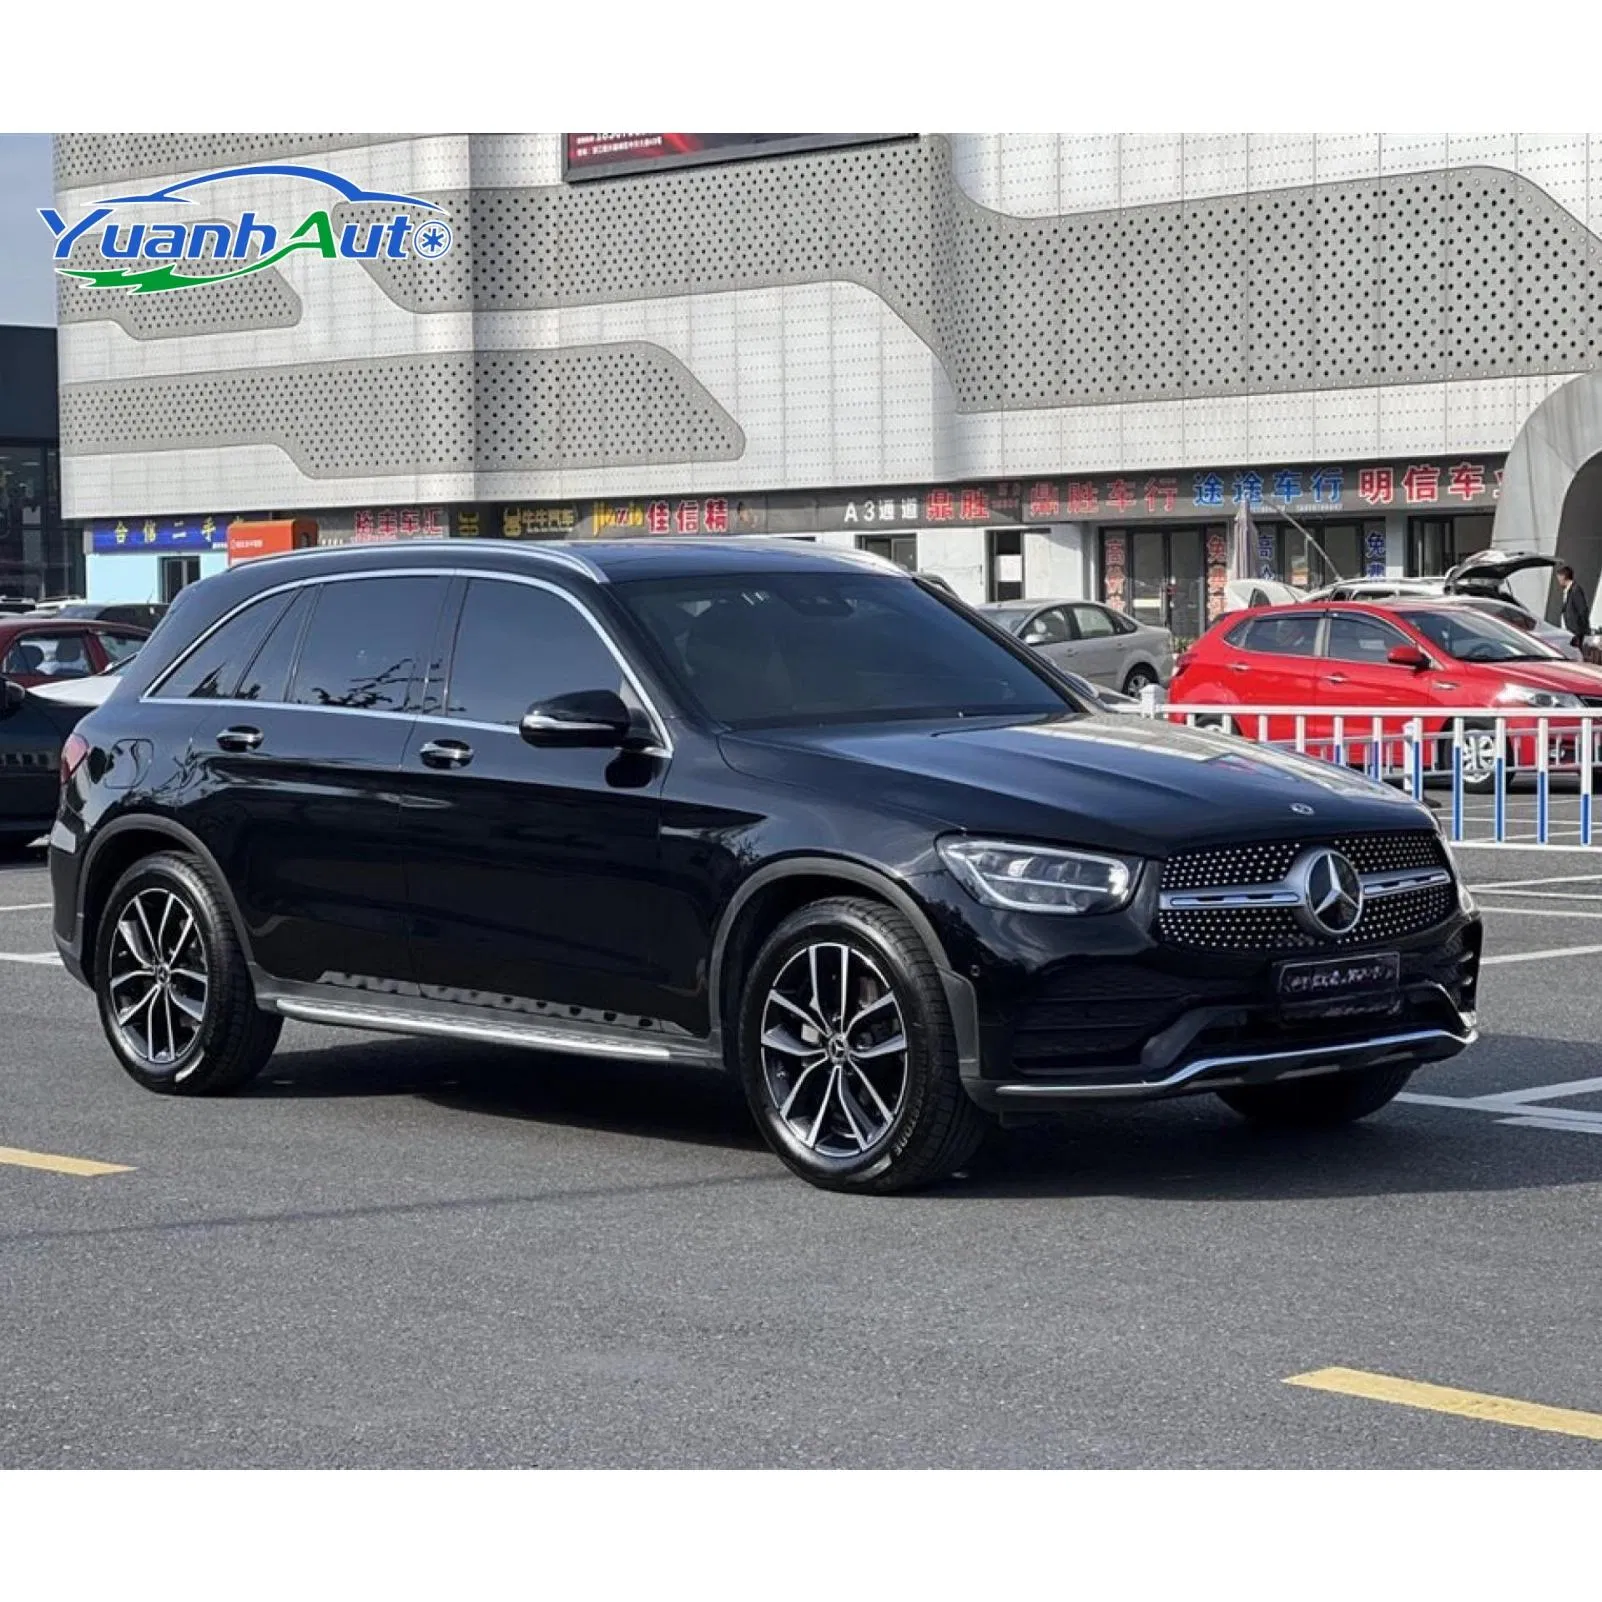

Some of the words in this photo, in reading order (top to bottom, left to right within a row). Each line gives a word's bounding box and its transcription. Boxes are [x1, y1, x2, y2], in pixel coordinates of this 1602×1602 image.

[1029, 477, 1178, 517] 鼎胜车行
[1193, 467, 1344, 507] 途途车行
